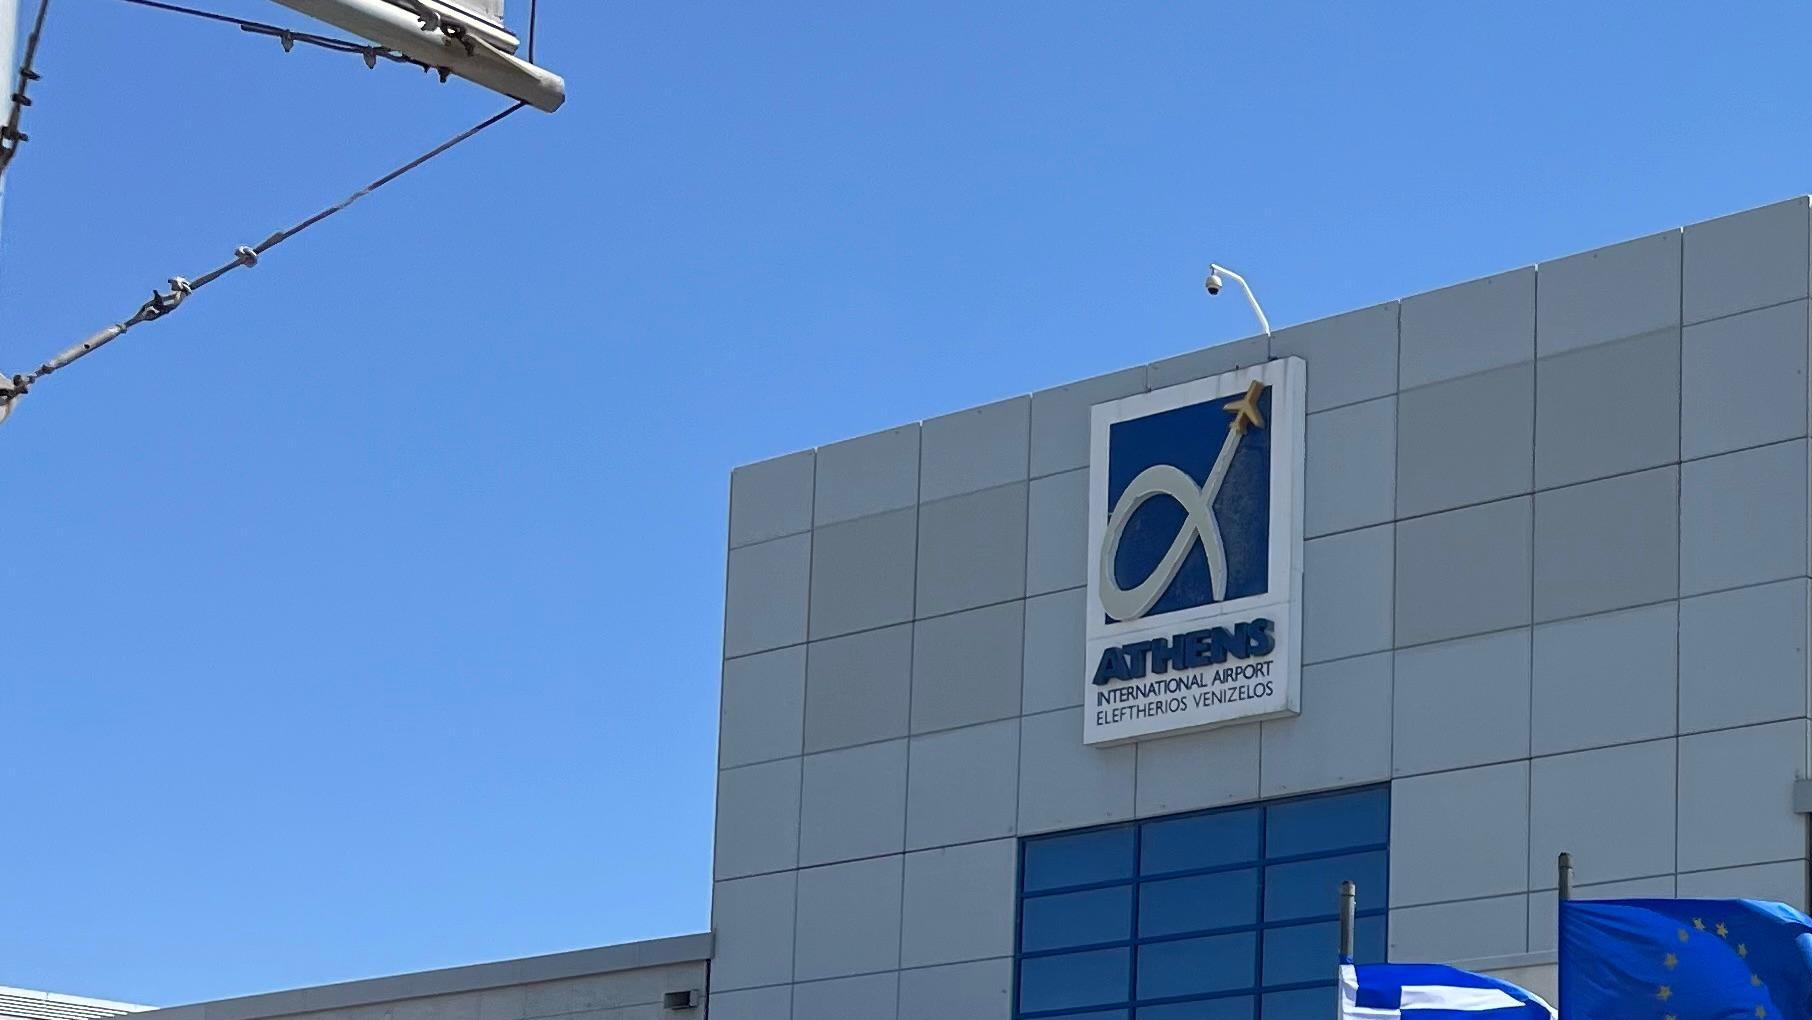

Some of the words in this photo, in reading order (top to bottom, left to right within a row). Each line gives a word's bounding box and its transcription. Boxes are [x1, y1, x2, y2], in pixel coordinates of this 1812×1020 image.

[1092, 618, 1275, 686] ATHENS
[1096, 697, 1187, 726] ELEFTHERIOS
[1193, 681, 1273, 709] VENIZELOS
[1097, 672, 1207, 707] INTERNATIONAL
[1212, 660, 1274, 686] AIRPORT
